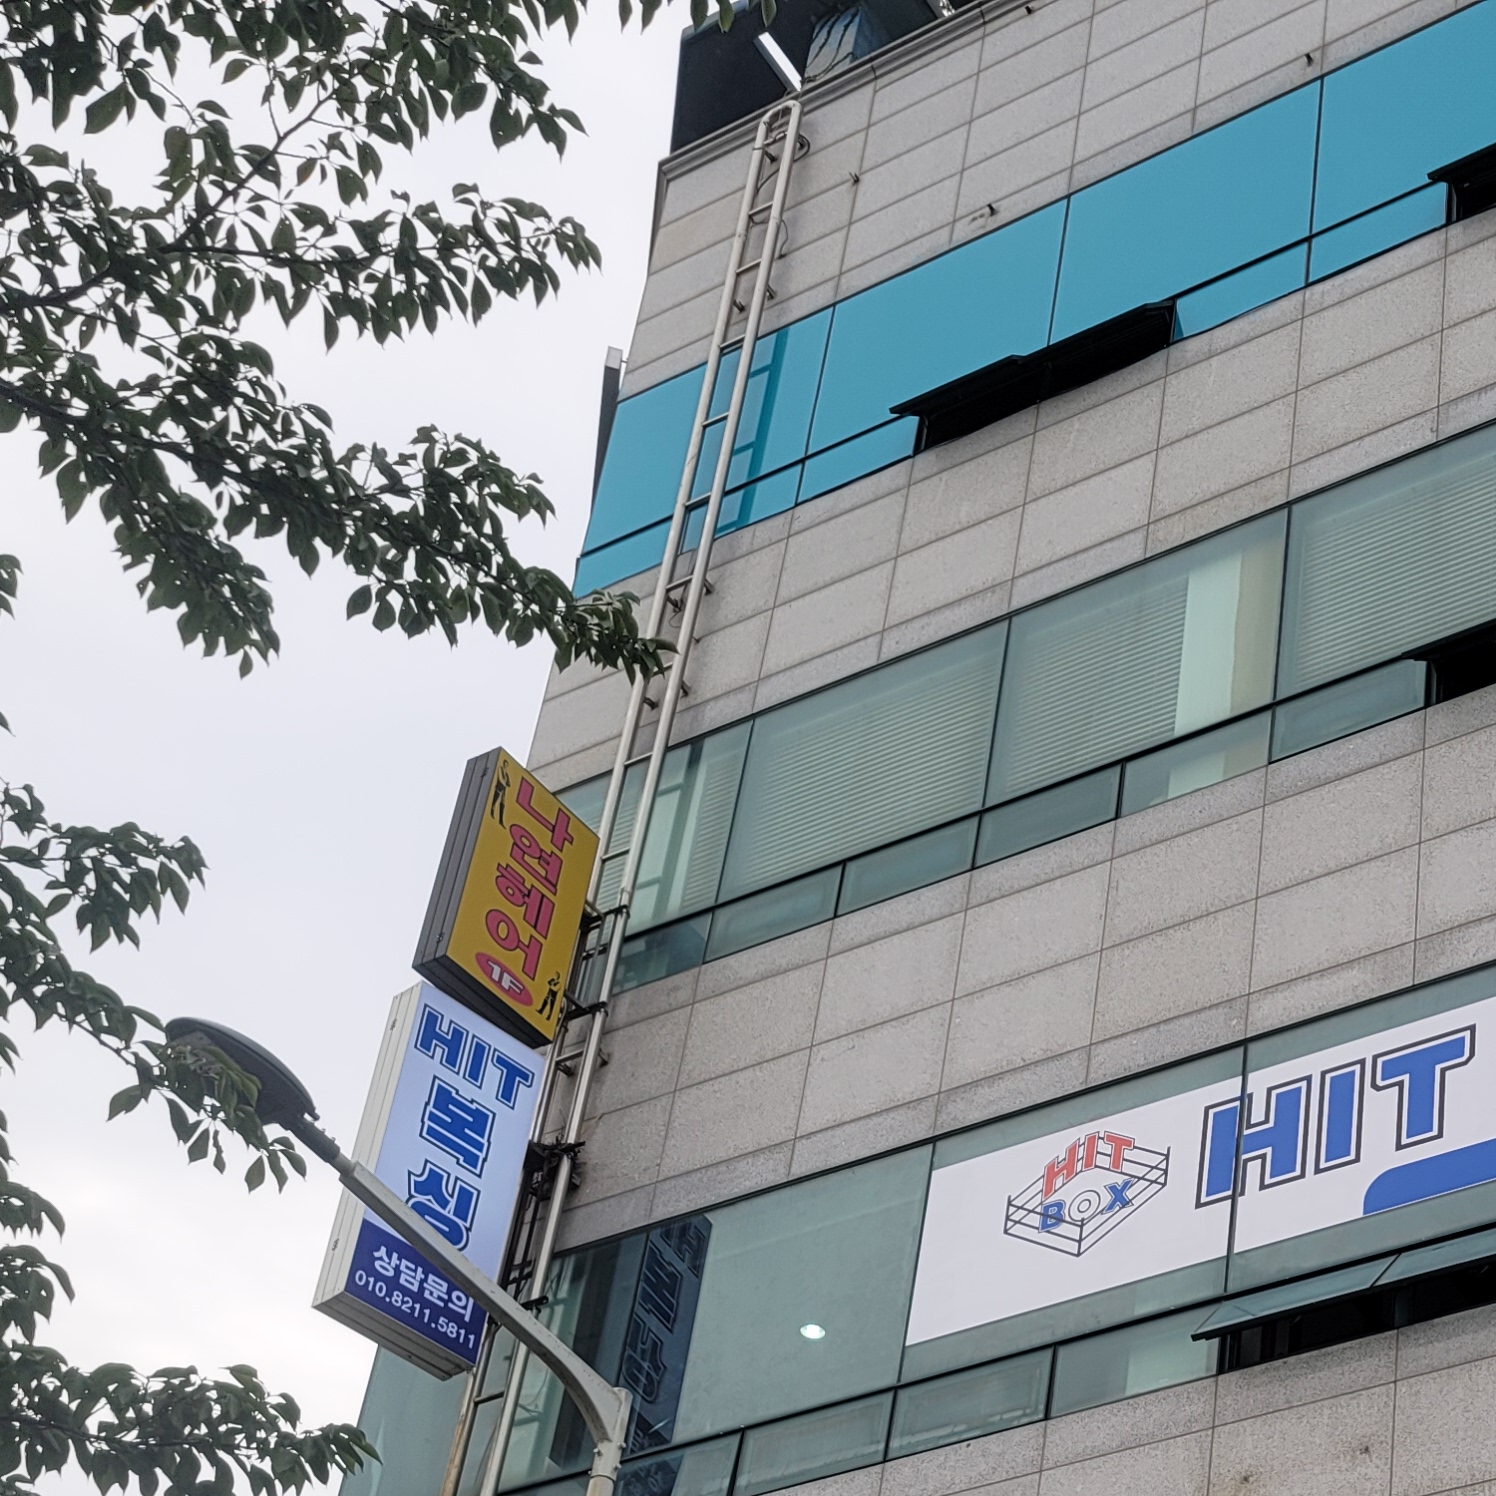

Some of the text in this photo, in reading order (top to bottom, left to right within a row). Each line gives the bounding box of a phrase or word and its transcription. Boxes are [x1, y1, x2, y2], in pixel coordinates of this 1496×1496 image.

[485, 776, 574, 981] 나연헤어
[487, 960, 524, 996] 1F
[414, 1003, 535, 1110] HIT
[1195, 1023, 1476, 1209] HIT
[407, 1075, 497, 1251] 복싱
[1042, 1131, 1135, 1203] HIT
[1038, 1178, 1134, 1233] BOX
[355, 1270, 475, 1349] 010.8211.5811
[373, 1246, 474, 1322] 상담문의
